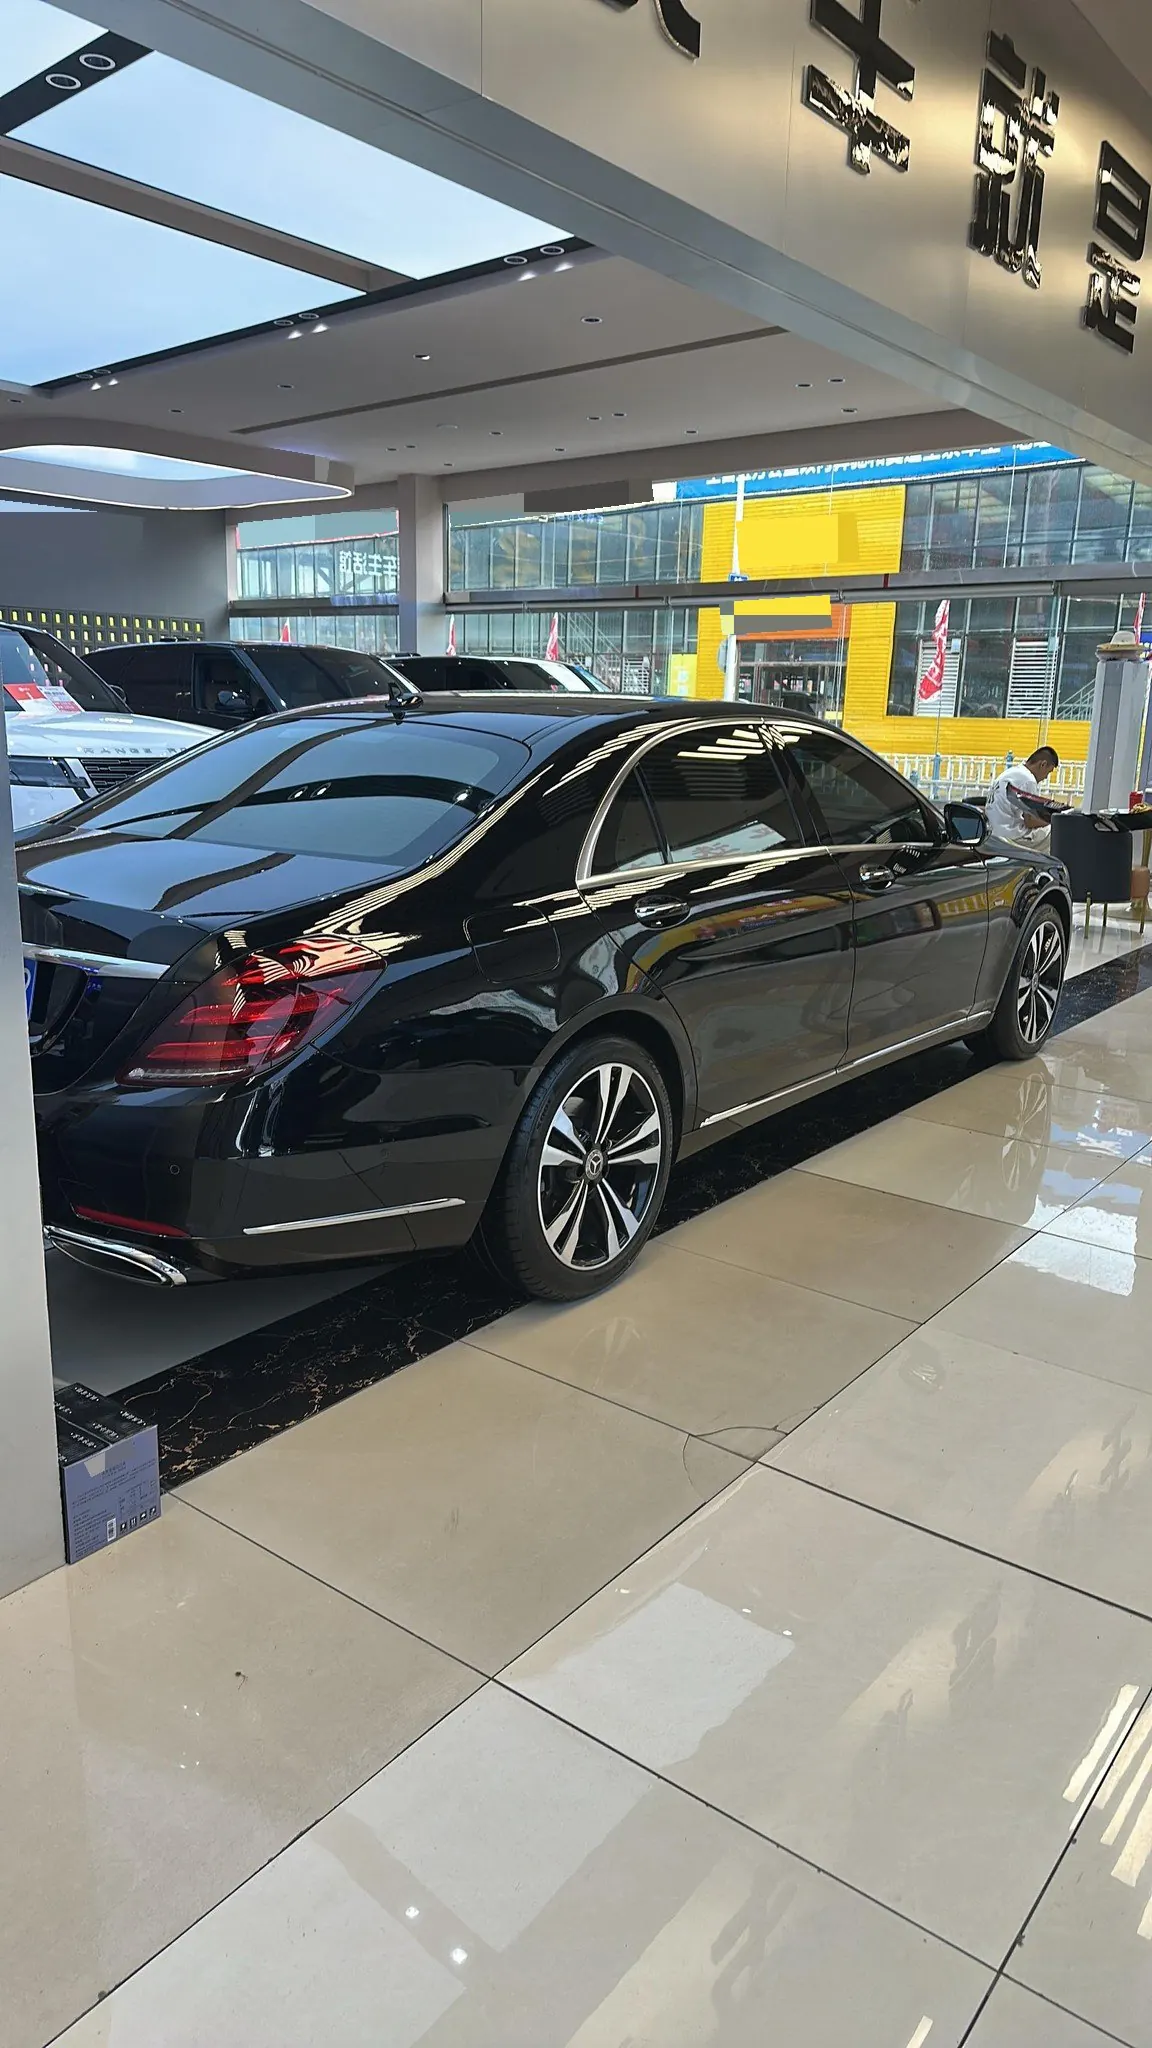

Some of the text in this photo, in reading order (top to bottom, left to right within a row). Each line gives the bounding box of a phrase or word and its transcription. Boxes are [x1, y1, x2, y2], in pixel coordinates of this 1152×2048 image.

[590, 0, 1151, 354] 车就是
[83, 746, 153, 755] RANGE
